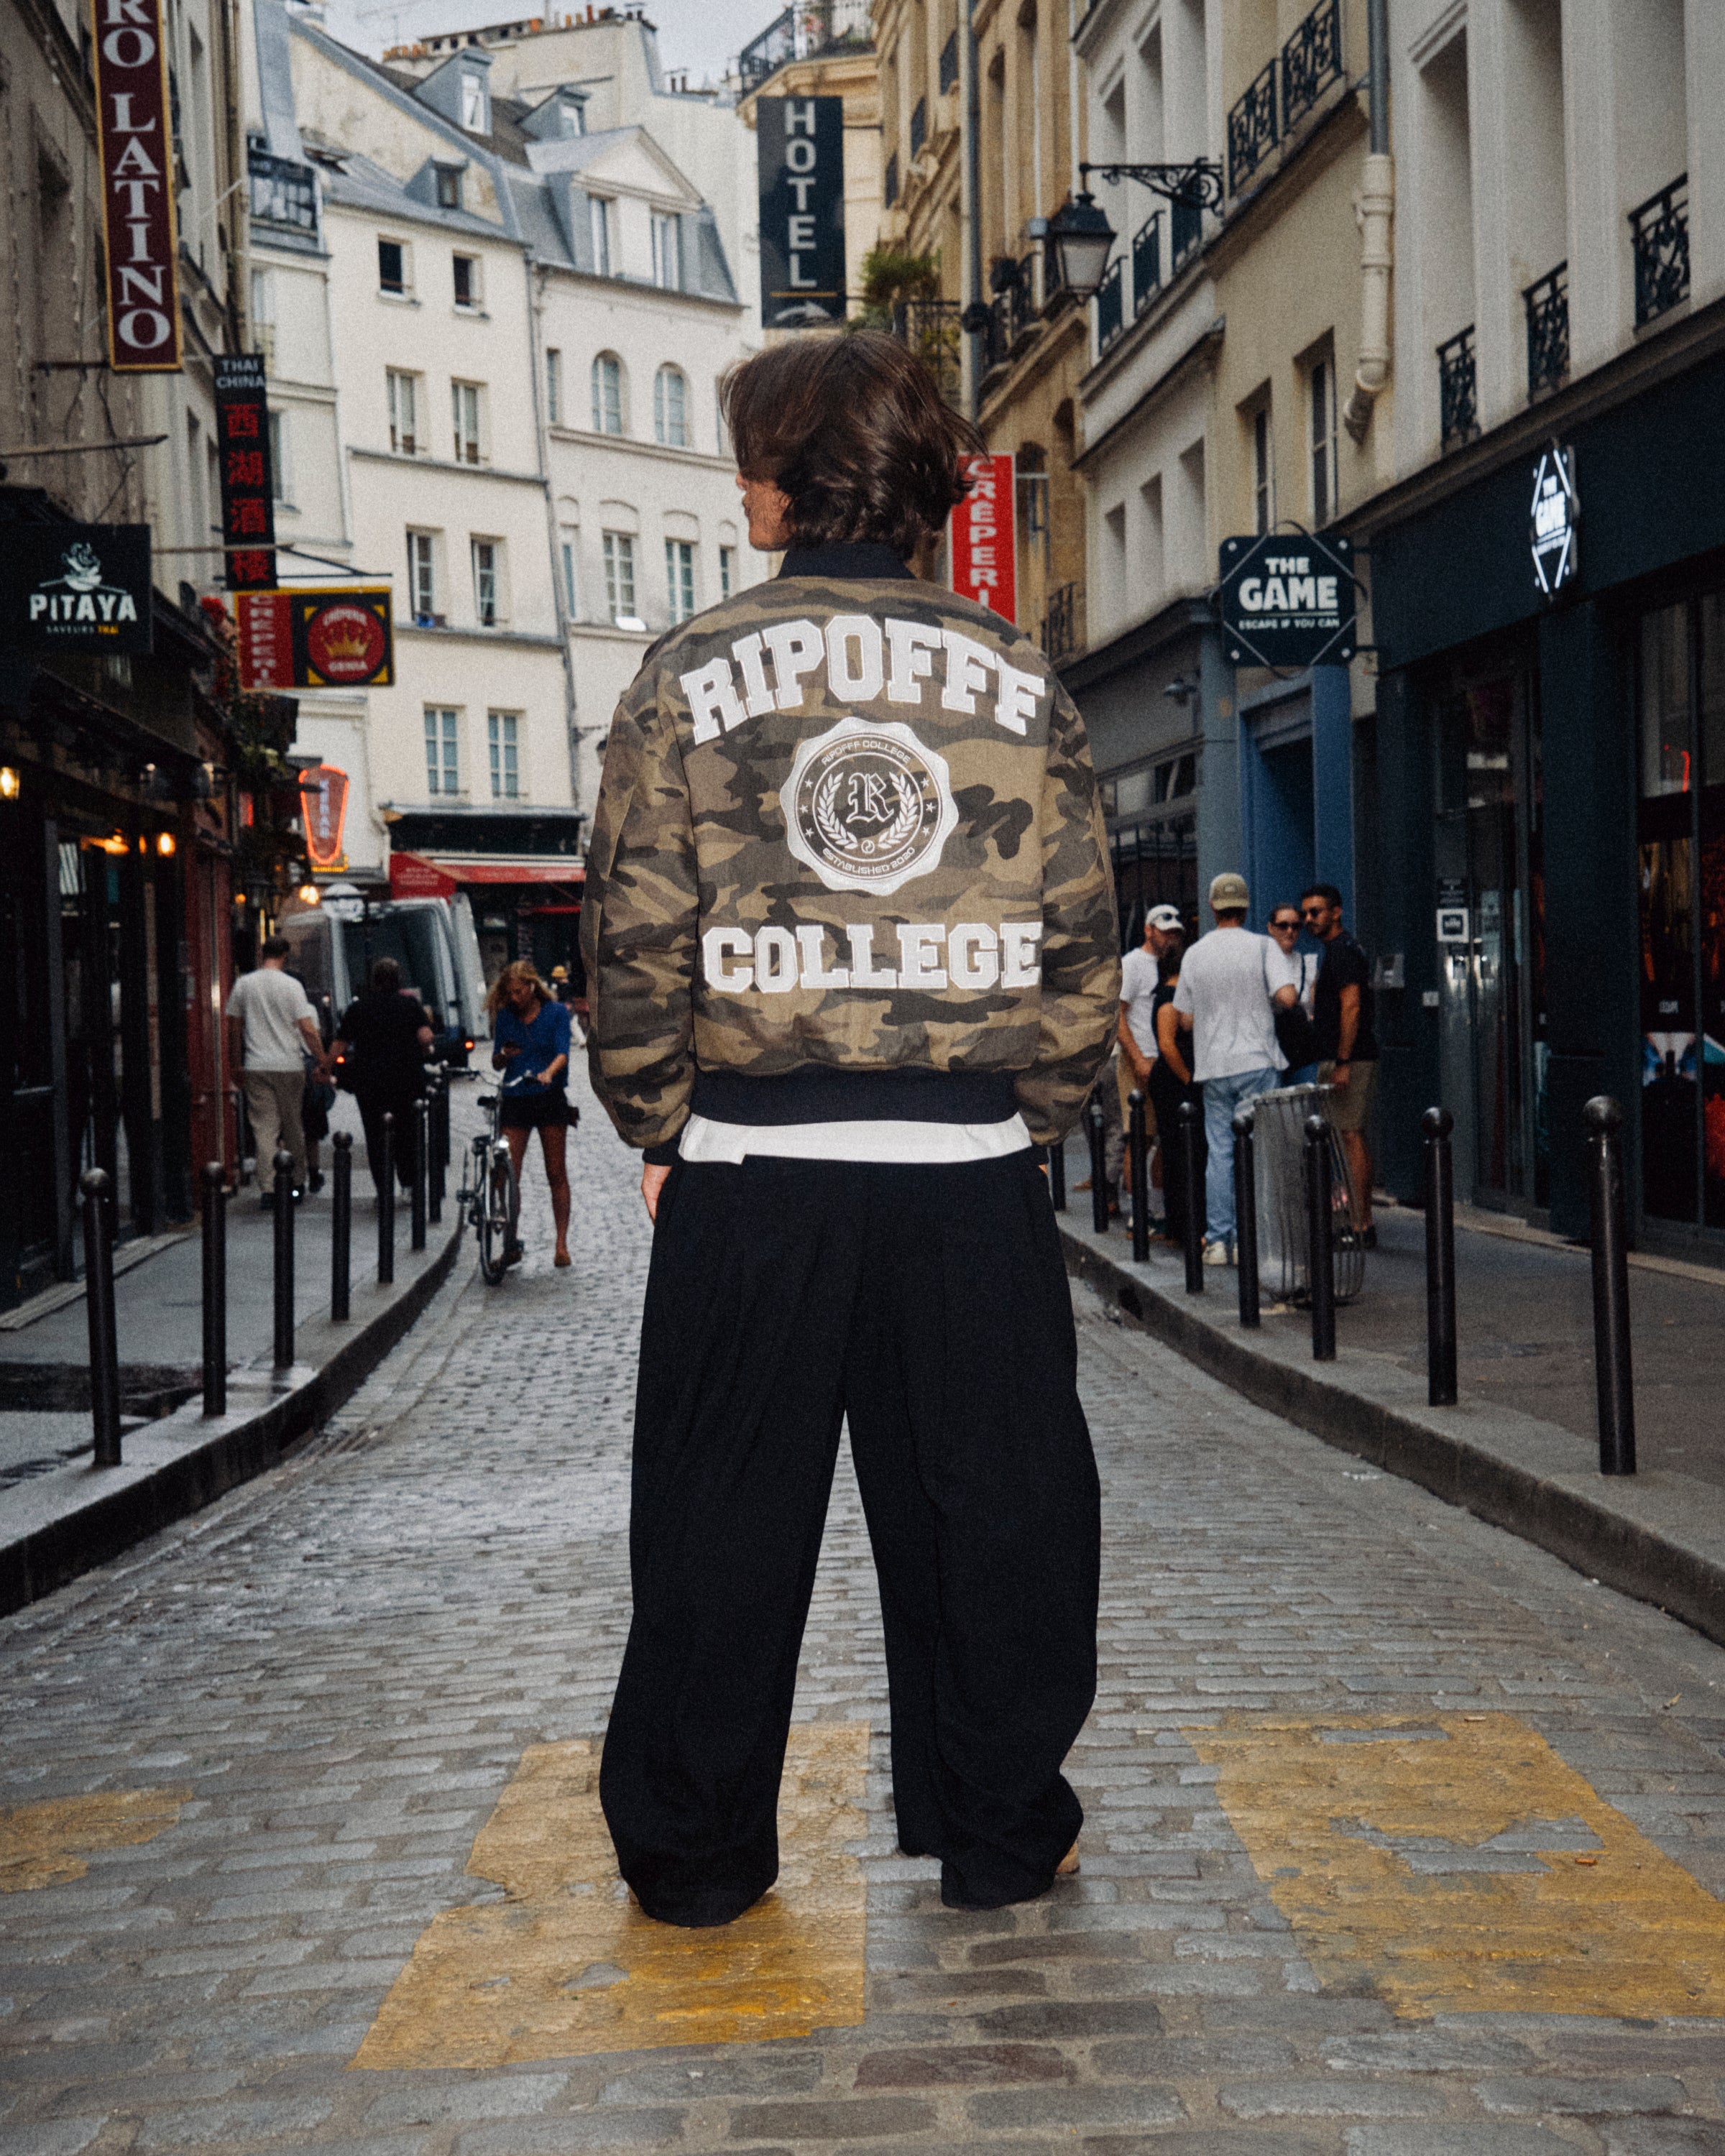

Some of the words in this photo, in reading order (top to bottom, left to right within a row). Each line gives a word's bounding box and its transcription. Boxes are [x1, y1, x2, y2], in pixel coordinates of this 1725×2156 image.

[784, 101, 817, 287] HOTEL
[110, 93, 171, 349] LATINO
[216, 375, 265, 389] CHINA
[1536, 491, 1565, 537] GAME
[1265, 557, 1310, 574] THE
[29, 594, 137, 622] PITAYA
[1239, 576, 1338, 610] GAME
[46, 625, 94, 634] SAVEURS
[1238, 619, 1277, 630] ESCAPE
[1281, 619, 1290, 629] IF
[1294, 619, 1315, 627] YOU
[1317, 618, 1340, 628] CAN
[680, 615, 1045, 745] RIPOFFF
[821, 741, 861, 765] RIPOFFF
[862, 740, 911, 765] COLLEGE
[846, 772, 895, 823] R
[822, 847, 890, 875] ESTABLISHED
[889, 847, 916, 869] 2020
[702, 921, 1043, 993] COLLEGE
